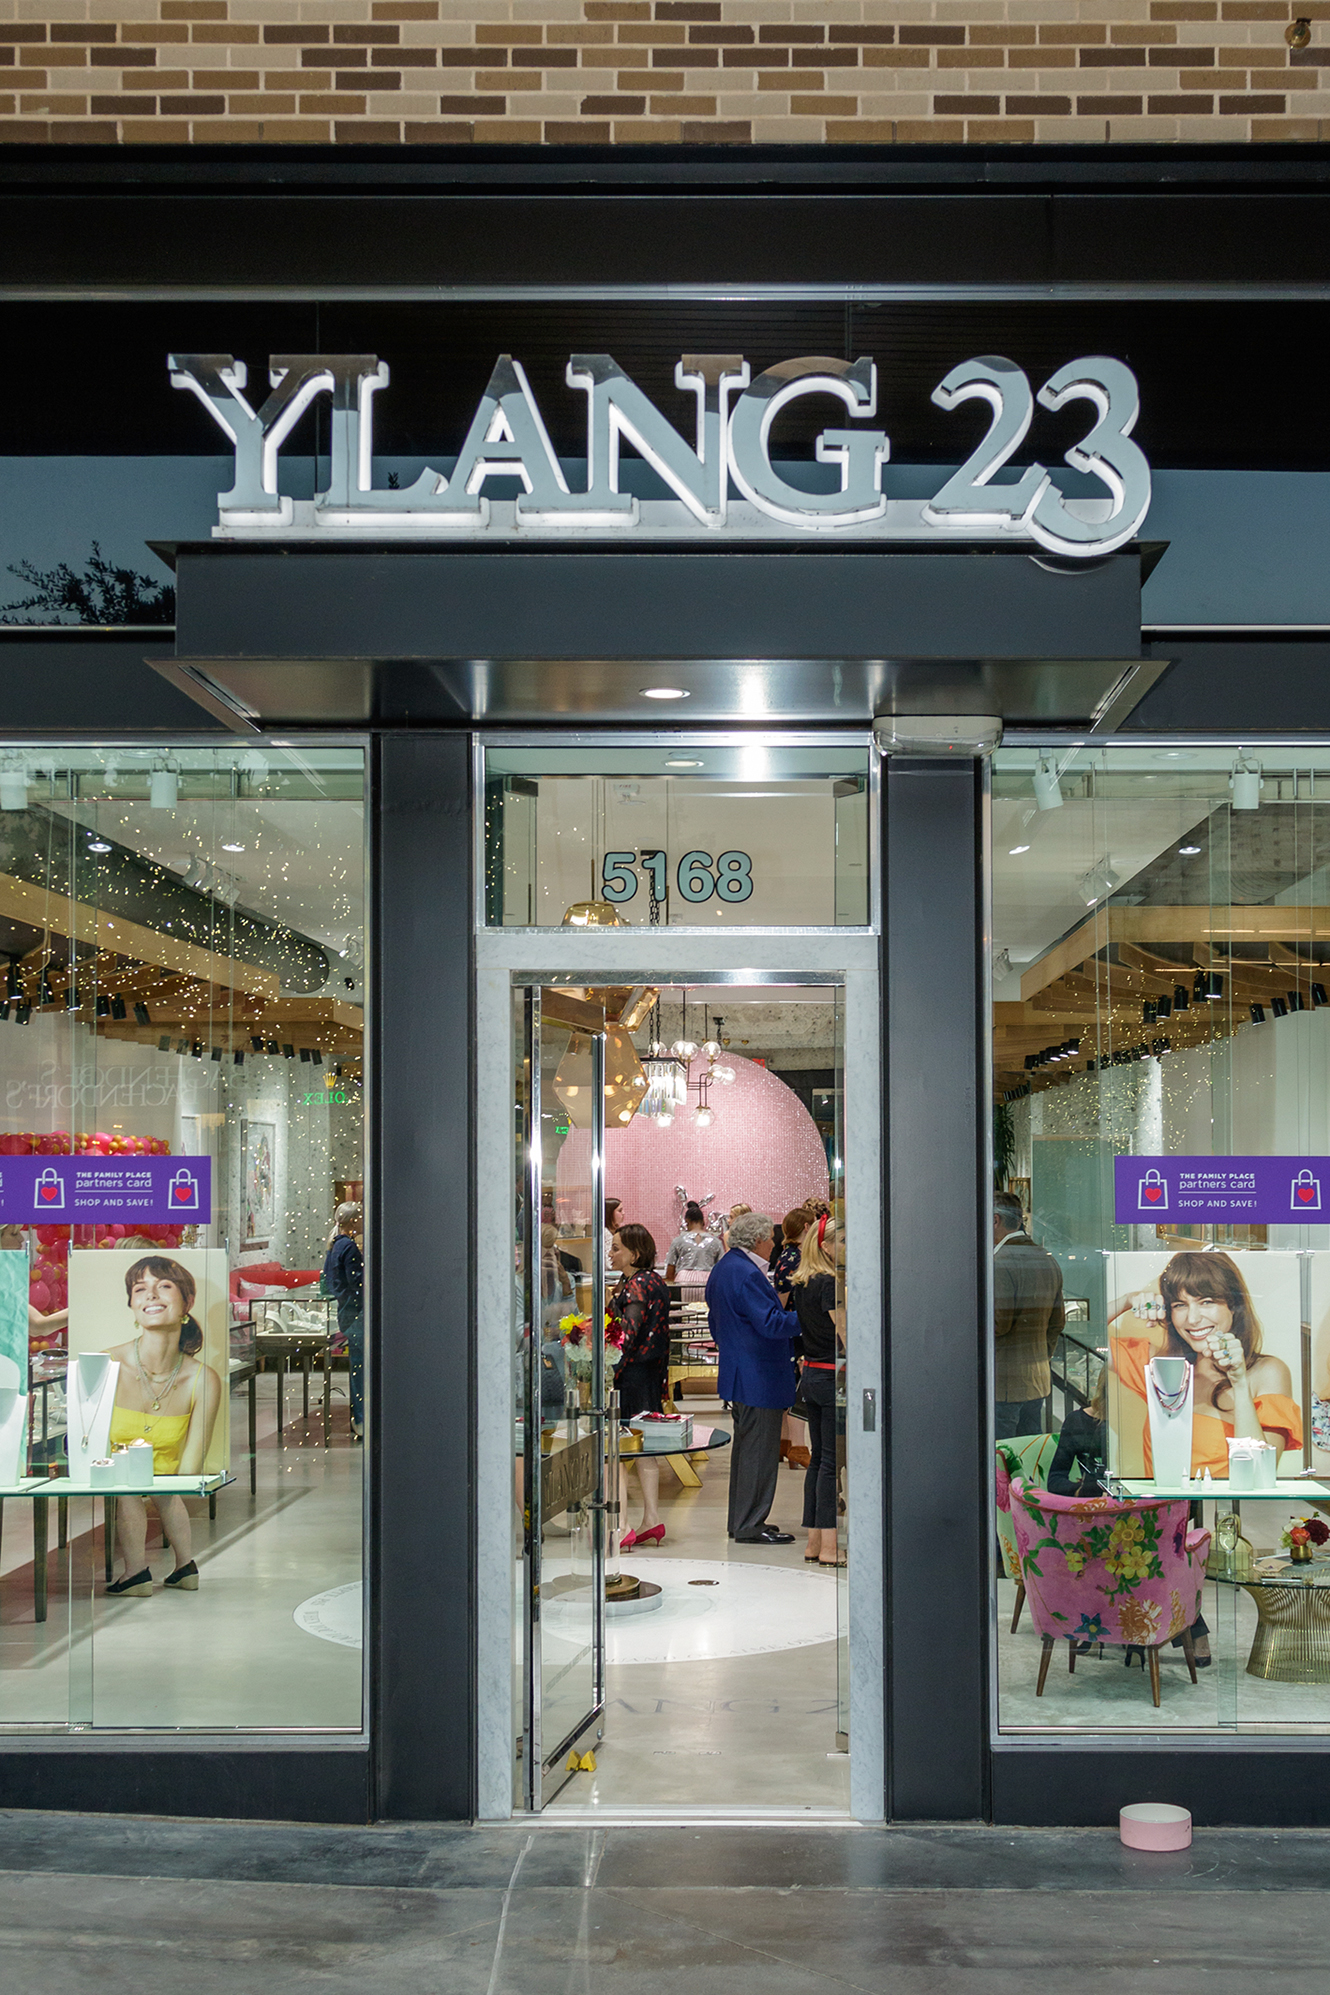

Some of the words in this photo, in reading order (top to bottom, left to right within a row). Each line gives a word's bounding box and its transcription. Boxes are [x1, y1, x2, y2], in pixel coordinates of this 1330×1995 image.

[168, 354, 889, 531] YLANG
[920, 355, 1151, 557] 23
[601, 850, 754, 904] 5168
[75, 1178, 123, 1189] partners
[126, 1178, 152, 1187] card
[1179, 1180, 1227, 1190] partners
[1230, 1179, 1256, 1189] card
[74, 1198, 101, 1206] SHOP
[103, 1198, 124, 1206] AND
[126, 1198, 154, 1206] SAVE!
[1178, 1200, 1204, 1208] SHOP
[1207, 1200, 1227, 1208] AND
[1230, 1200, 1257, 1208] SAVE!
